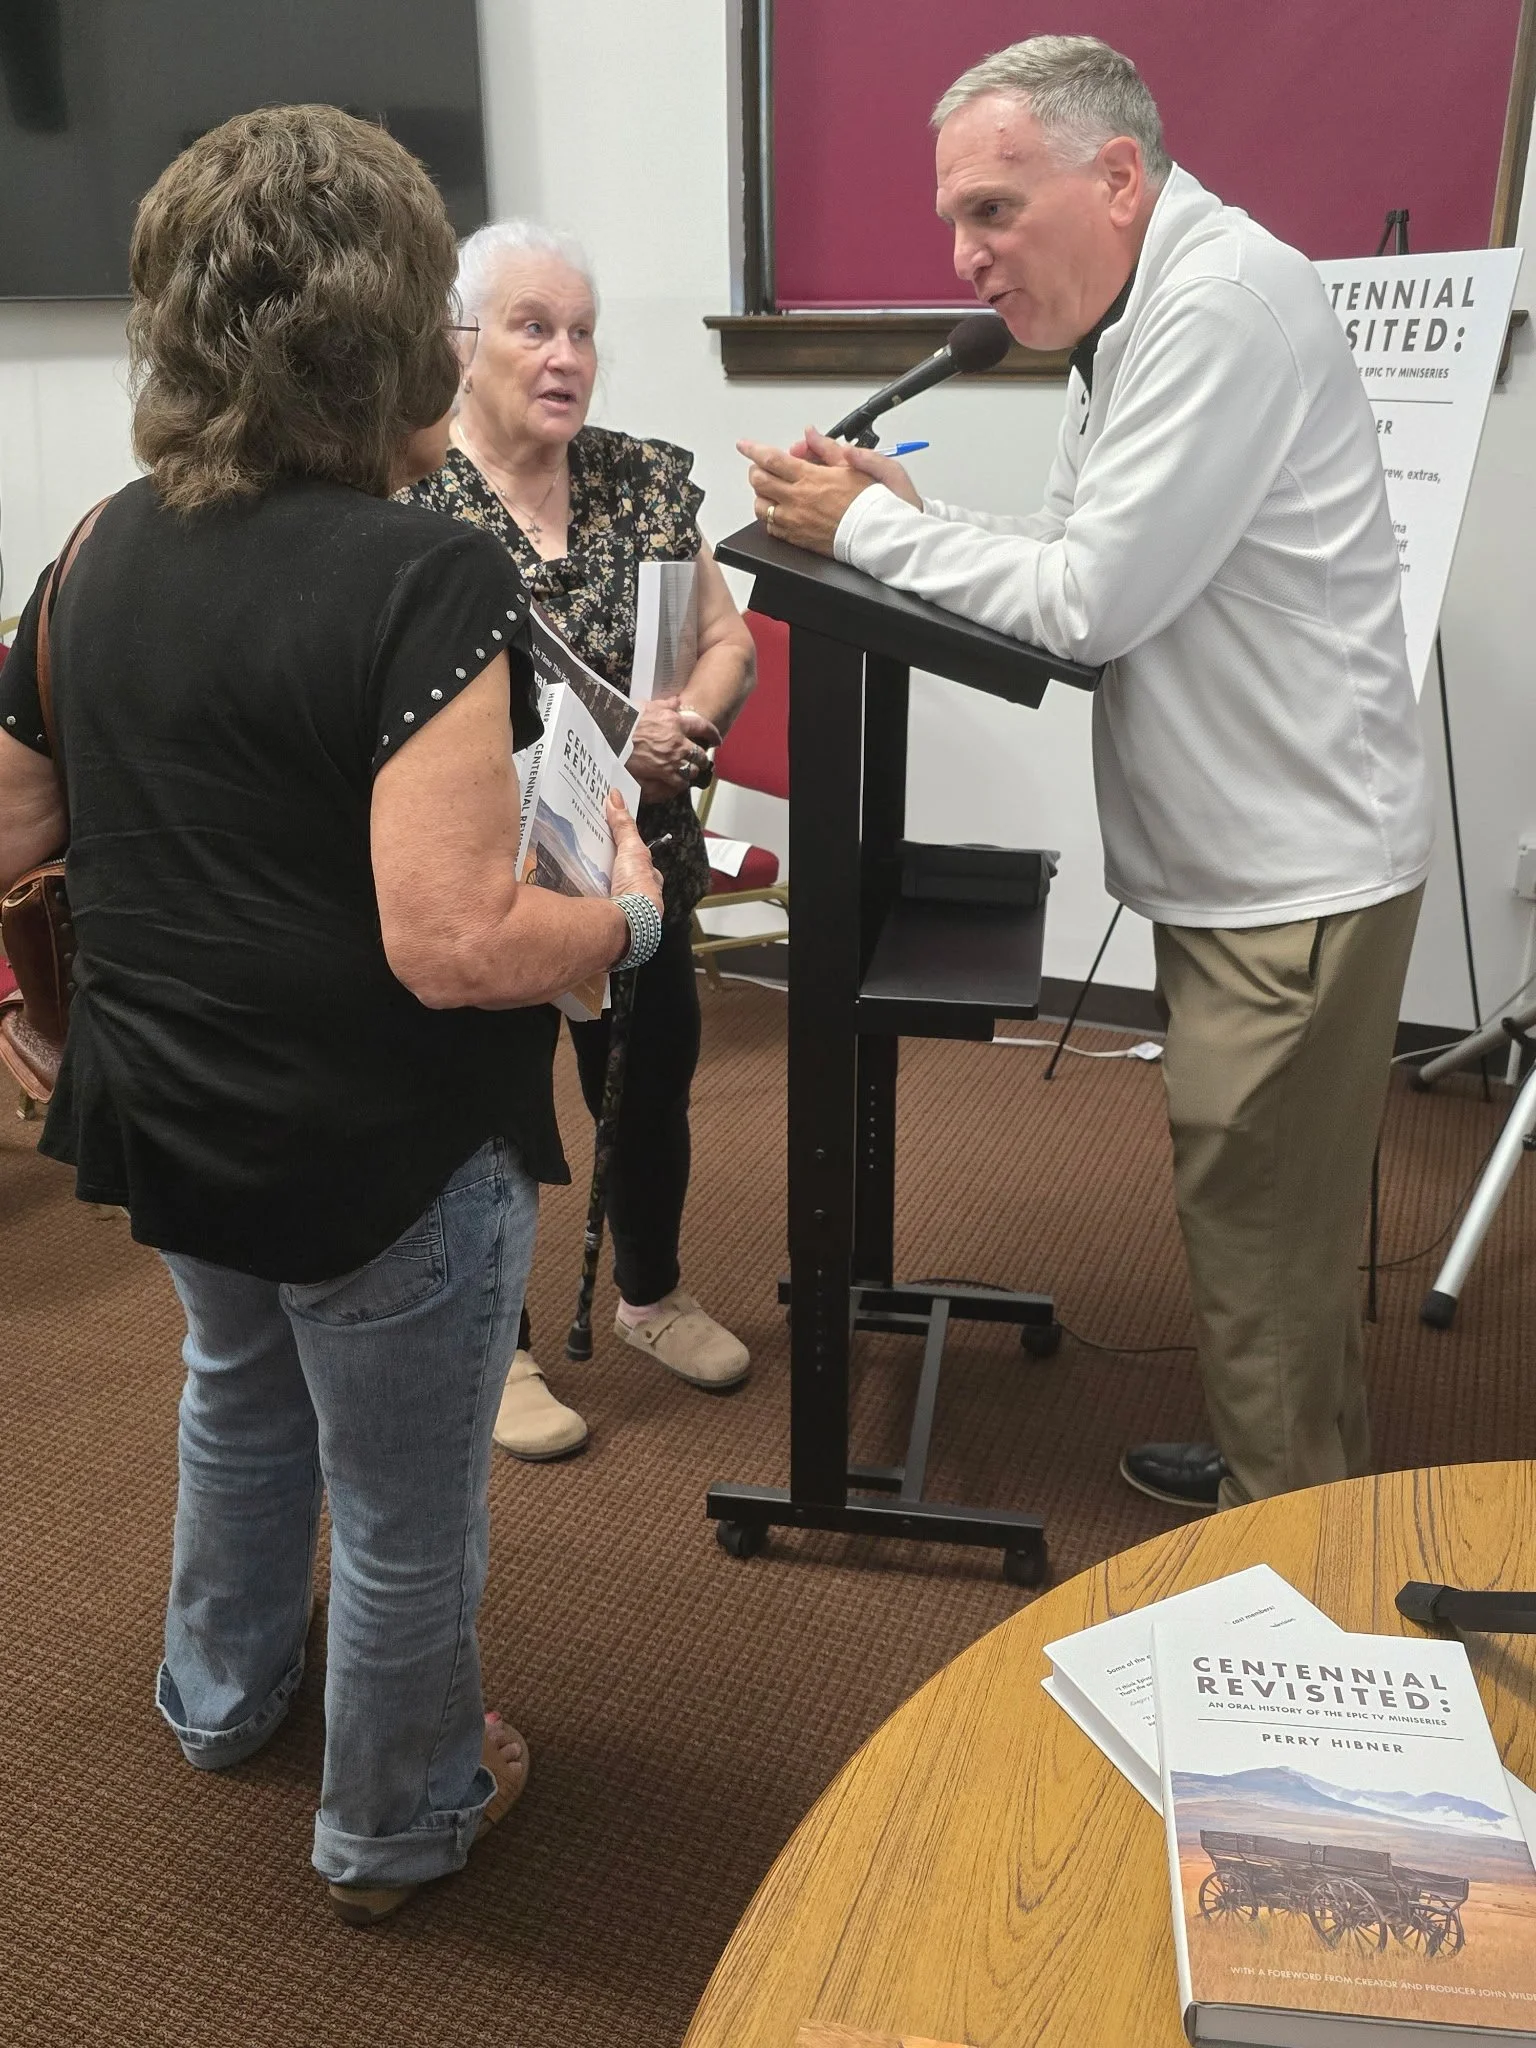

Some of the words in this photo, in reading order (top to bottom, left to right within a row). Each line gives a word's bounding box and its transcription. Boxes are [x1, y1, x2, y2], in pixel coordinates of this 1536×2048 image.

[1322, 276, 1475, 311] TENNIAL
[1345, 318, 1466, 353] SITED:
[1364, 367, 1383, 378] EPIC
[1385, 367, 1397, 378] TV
[1398, 367, 1450, 379] MINISERIES
[1384, 468, 1403, 481] rew,
[1407, 469, 1441, 484] extras,
[521, 743, 544, 812] CENTENNIAL
[563, 742, 606, 806] REVISIT
[567, 729, 611, 796] CENTENN
[1193, 1656, 1447, 1691] CENTENNIAL
[1197, 1676, 1451, 1713] REVISITED:
[1208, 1701, 1224, 1709] AN
[1227, 1702, 1256, 1711] ORAL
[1258, 1705, 1302, 1715] HISTORY
[1346, 1711, 1369, 1720] EPIC
[1371, 1713, 1385, 1721] TV
[1388, 1715, 1448, 1726] MINISERIES
[1262, 1733, 1320, 1746] PERRY
[1331, 1739, 1404, 1753] HIBNER
[1230, 1966, 1255, 1976] WITH
[1267, 1969, 1322, 1981] FOREWORD
[1325, 1974, 1353, 1985] FROM
[1354, 1977, 1398, 1989] CREATOR
[1400, 1980, 1423, 1991] AND
[1425, 1984, 1476, 1996] PRODUCER
[1478, 1988, 1507, 1998] JOHN
